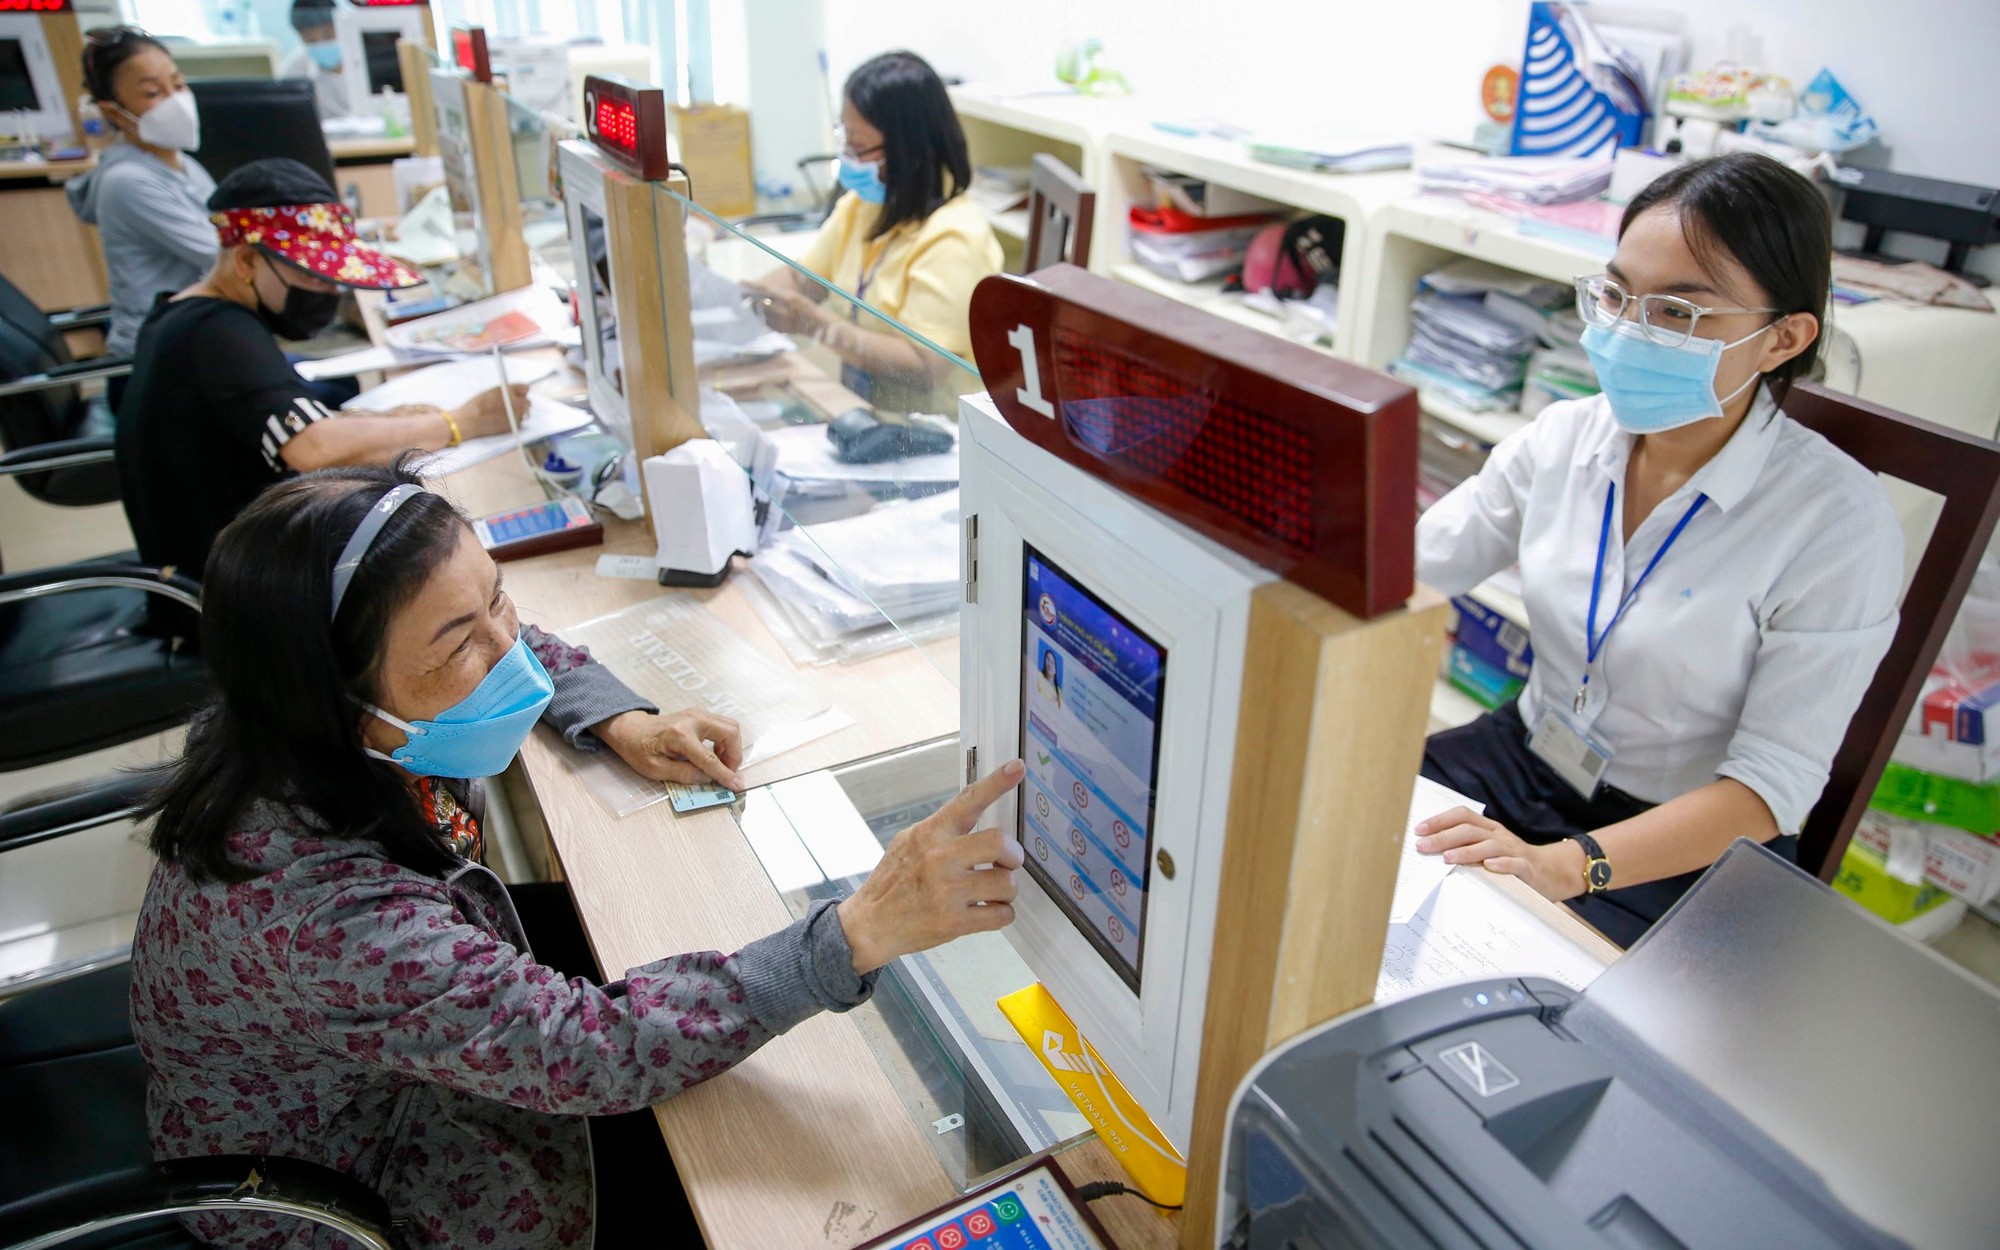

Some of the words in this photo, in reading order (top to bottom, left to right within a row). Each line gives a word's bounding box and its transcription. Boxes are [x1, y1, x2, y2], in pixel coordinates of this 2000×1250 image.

[586, 91, 598, 136] 2
[1007, 323, 1055, 420] 1
[629, 631, 707, 692] CLEAR
[1070, 1082, 1108, 1127] VIETNAM
